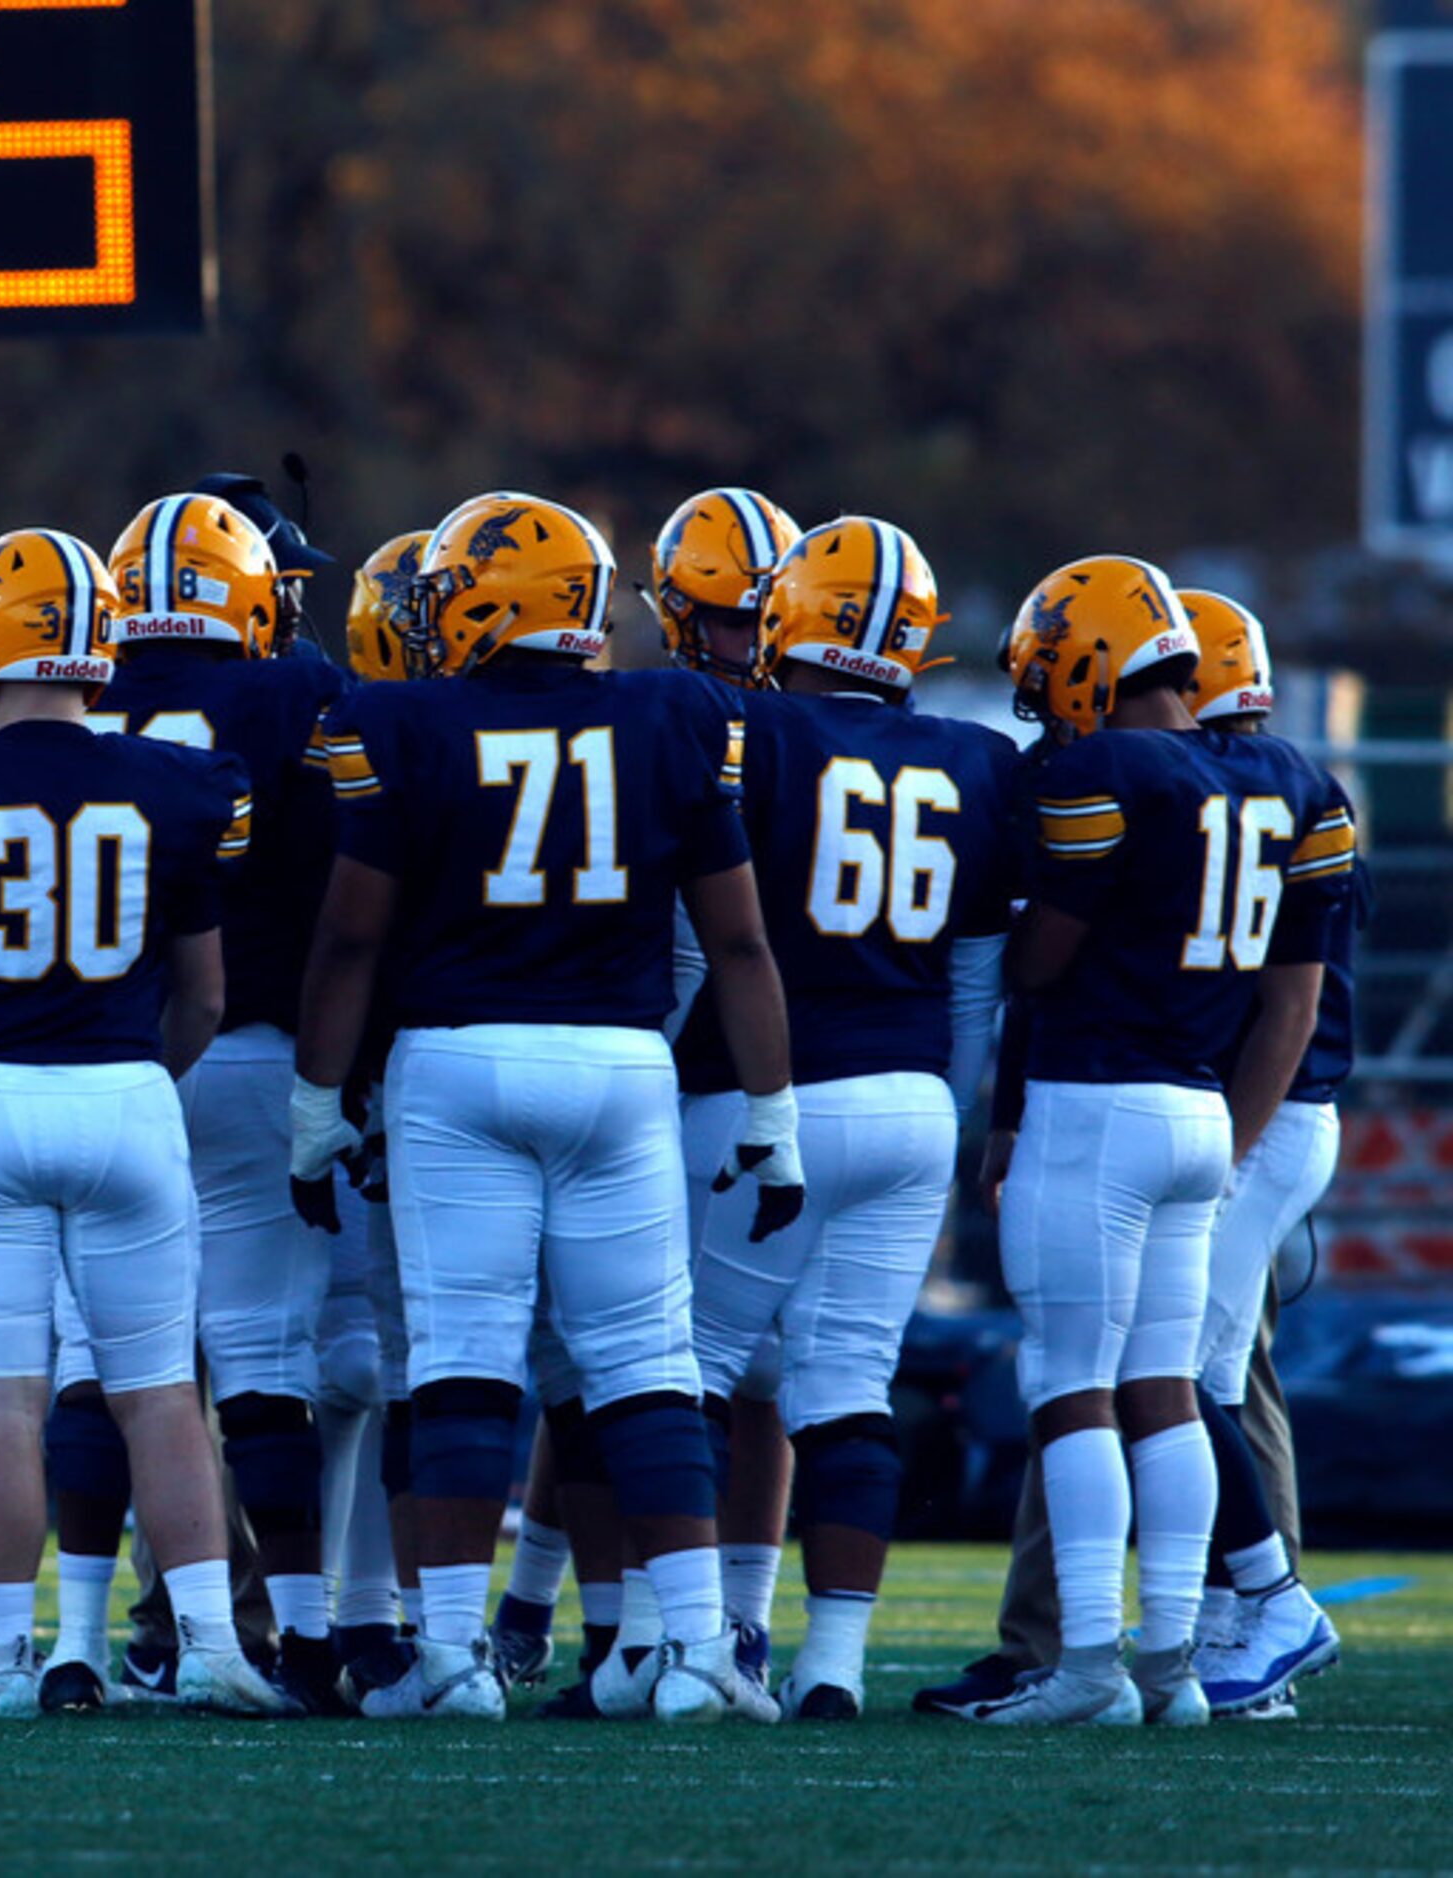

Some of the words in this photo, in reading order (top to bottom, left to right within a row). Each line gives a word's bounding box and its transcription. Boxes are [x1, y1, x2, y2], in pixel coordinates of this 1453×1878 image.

[126, 618, 205, 637] Riddell
[178, 567, 198, 600] 8
[822, 648, 901, 682] Riddell
[473, 724, 631, 909] 71
[804, 754, 963, 945] 66
[1178, 793, 1296, 972] 16
